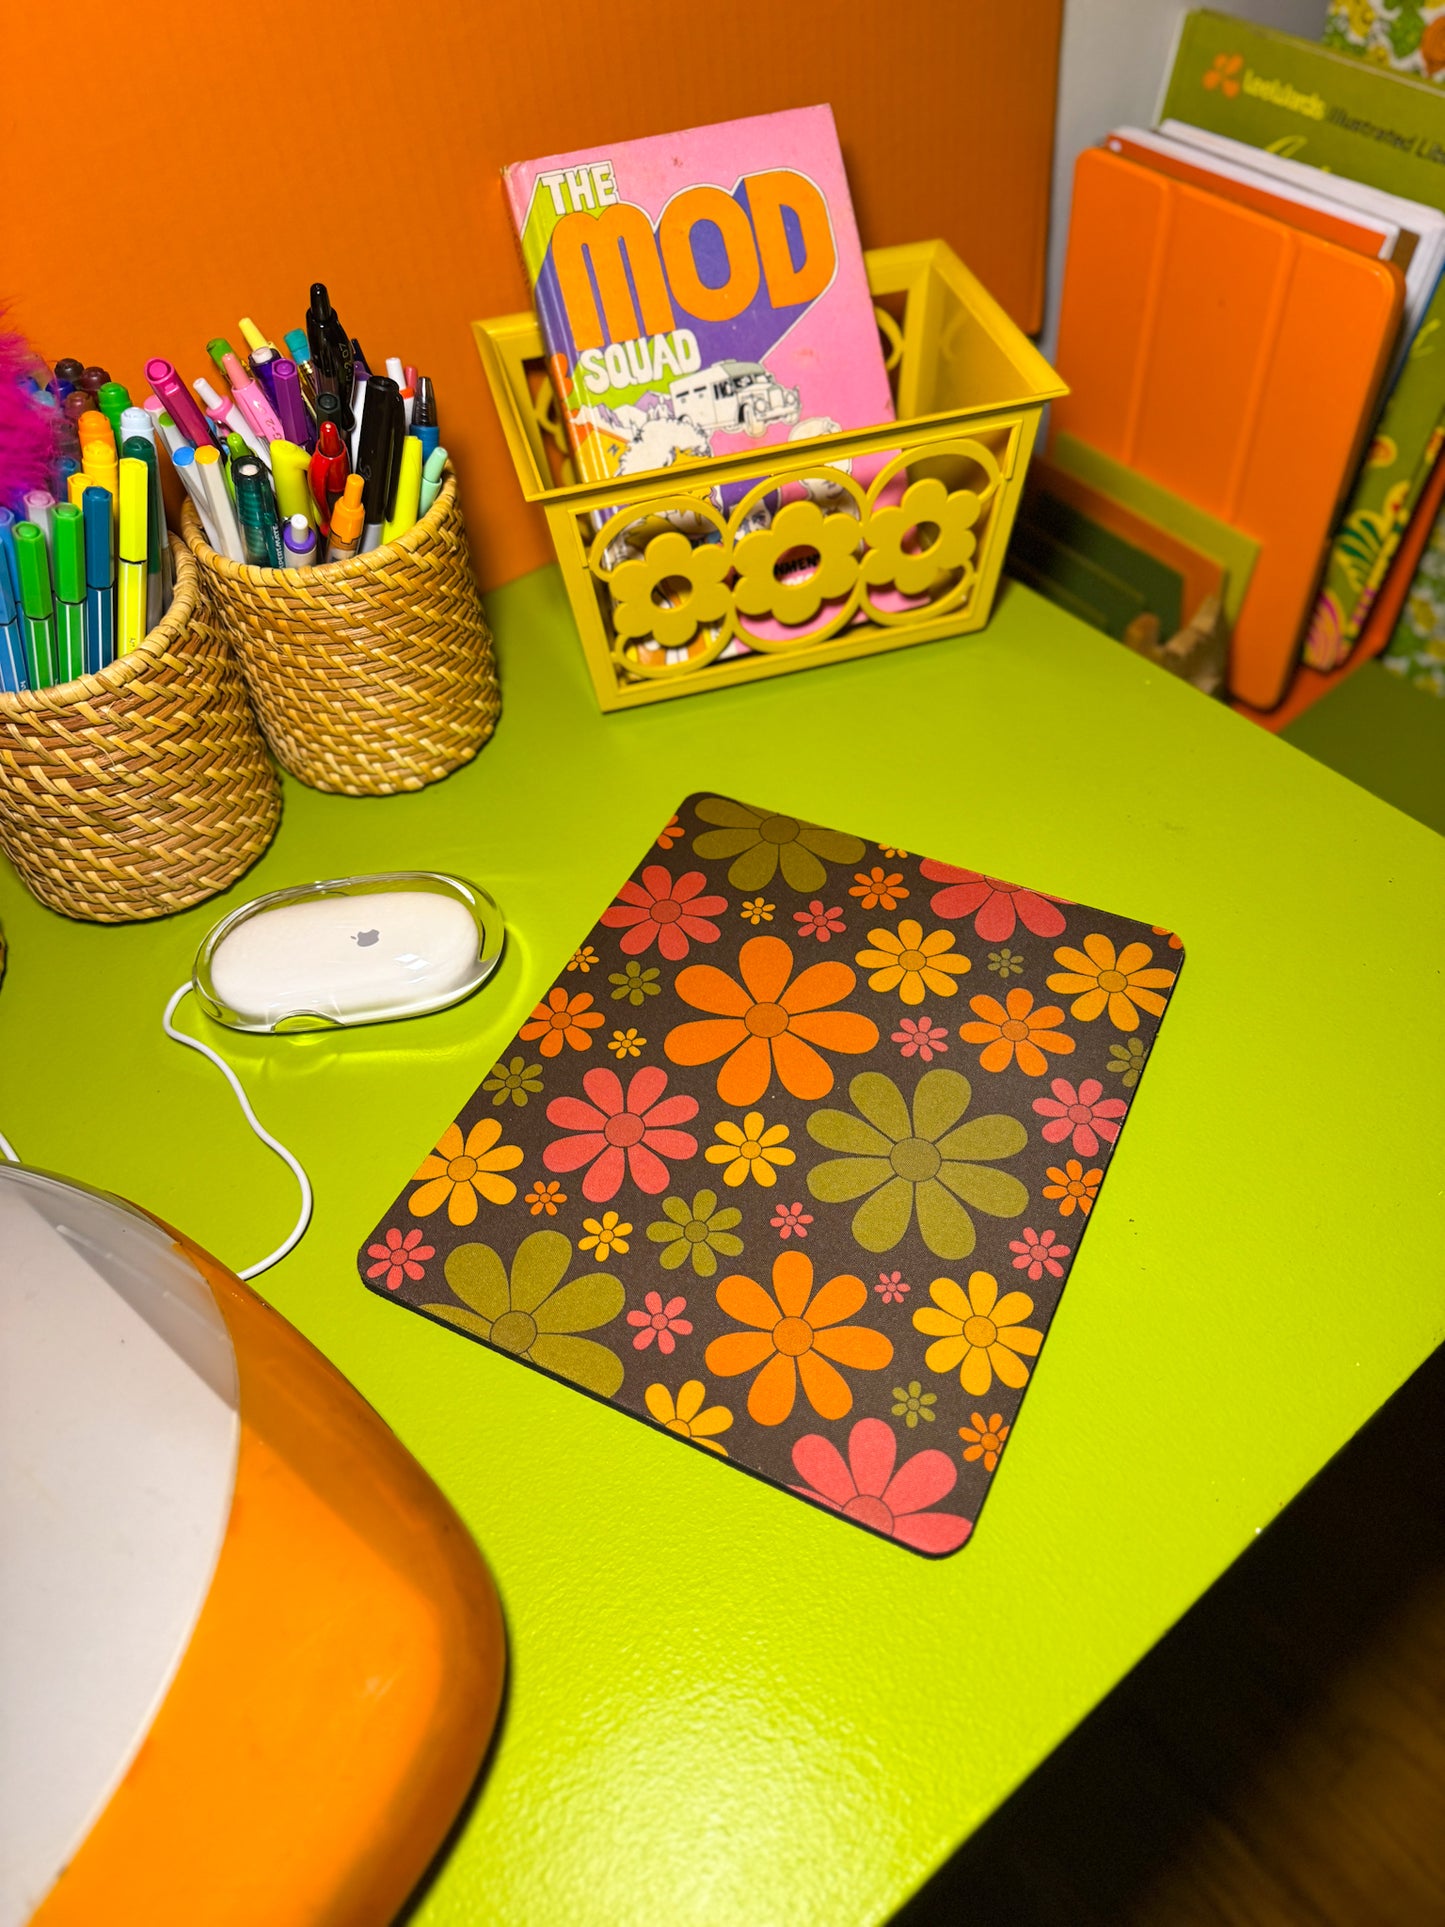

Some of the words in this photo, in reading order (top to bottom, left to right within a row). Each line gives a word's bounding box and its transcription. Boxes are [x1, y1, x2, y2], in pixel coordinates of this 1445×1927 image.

[541, 165, 619, 216] THE
[551, 170, 836, 351] MOD
[580, 329, 701, 394] SQUAD
